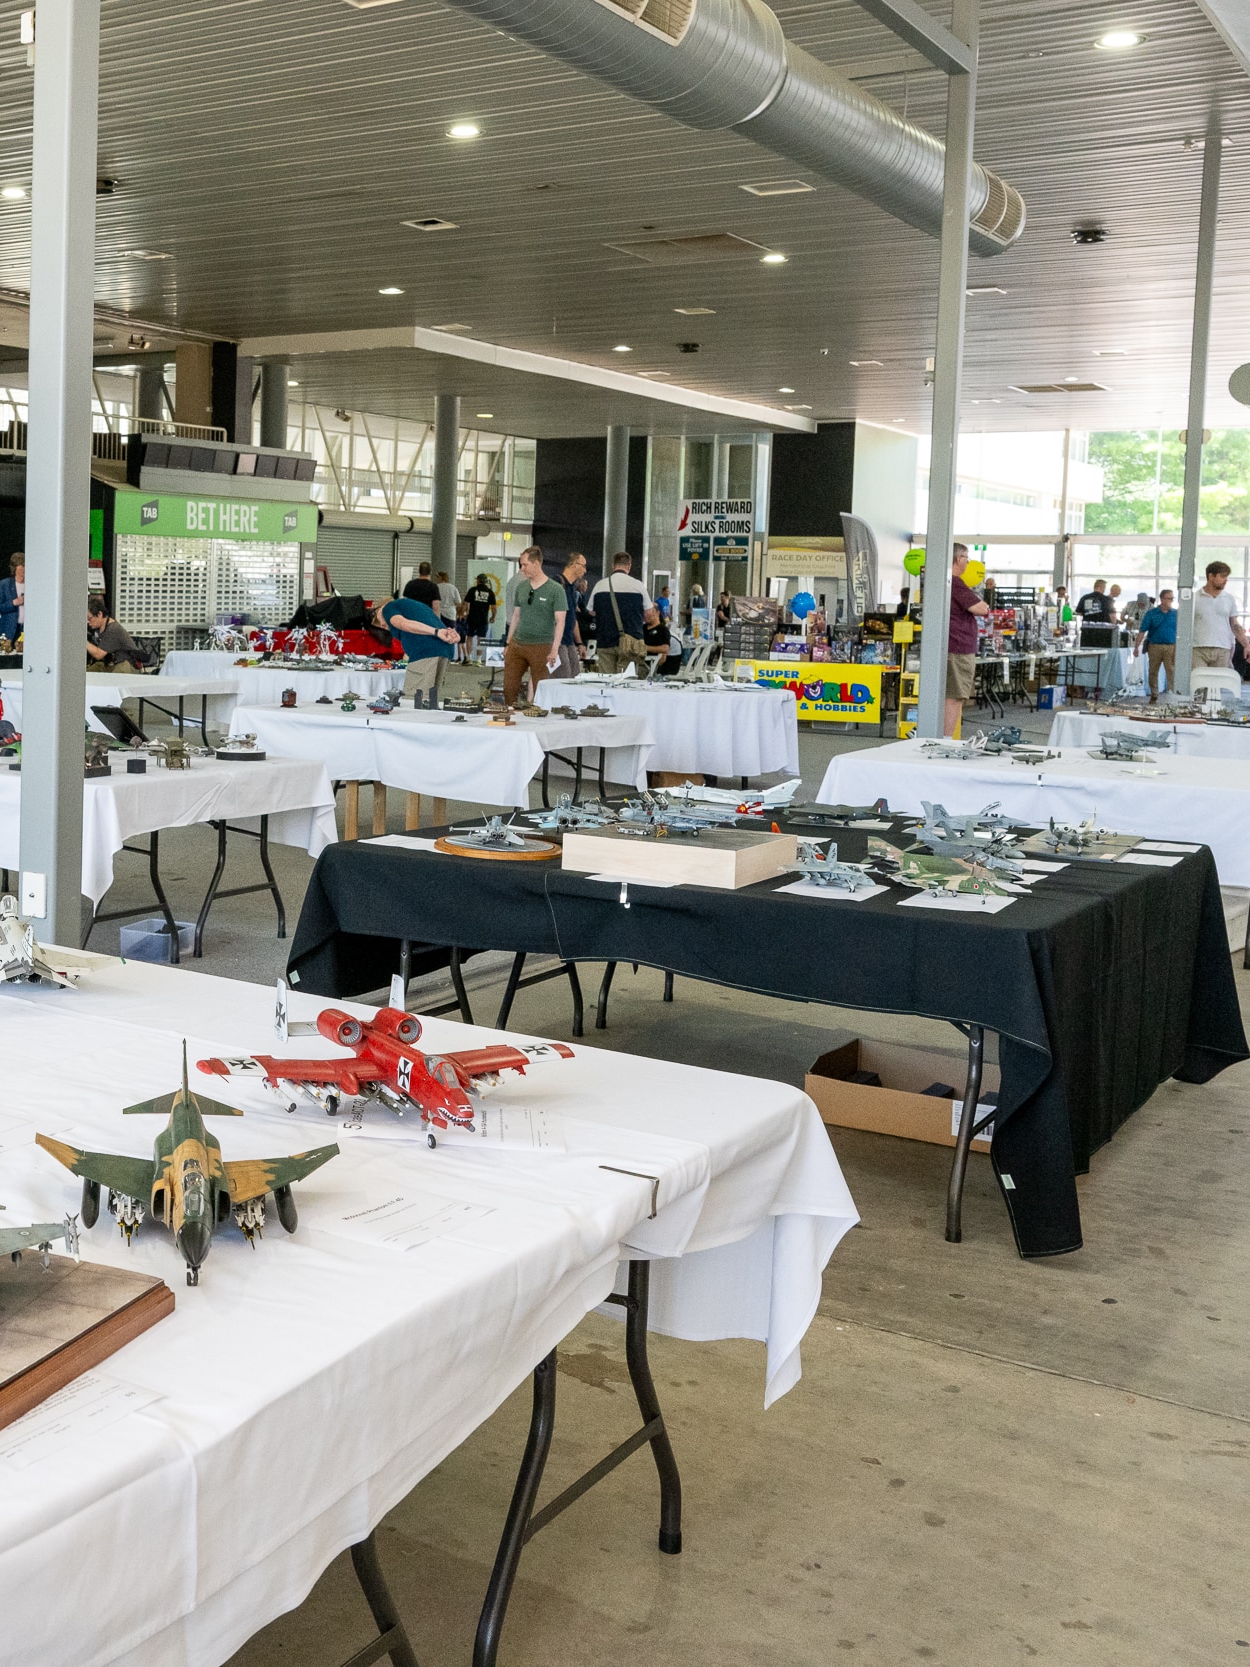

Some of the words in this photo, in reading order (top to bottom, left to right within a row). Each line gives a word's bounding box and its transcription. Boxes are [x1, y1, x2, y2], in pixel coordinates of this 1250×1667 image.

[142, 506, 158, 519] TAB
[691, 501, 712, 514] RICH
[714, 501, 752, 514] REWARD
[186, 501, 216, 531] BET
[219, 503, 259, 533] HERE
[284, 516, 297, 527] TAB
[691, 520, 716, 533] SILKS
[718, 520, 751, 533] ROOMS
[796, 554, 813, 562] DAY
[758, 669, 799, 678] SUPER
[814, 703, 866, 712] HOBBIES
